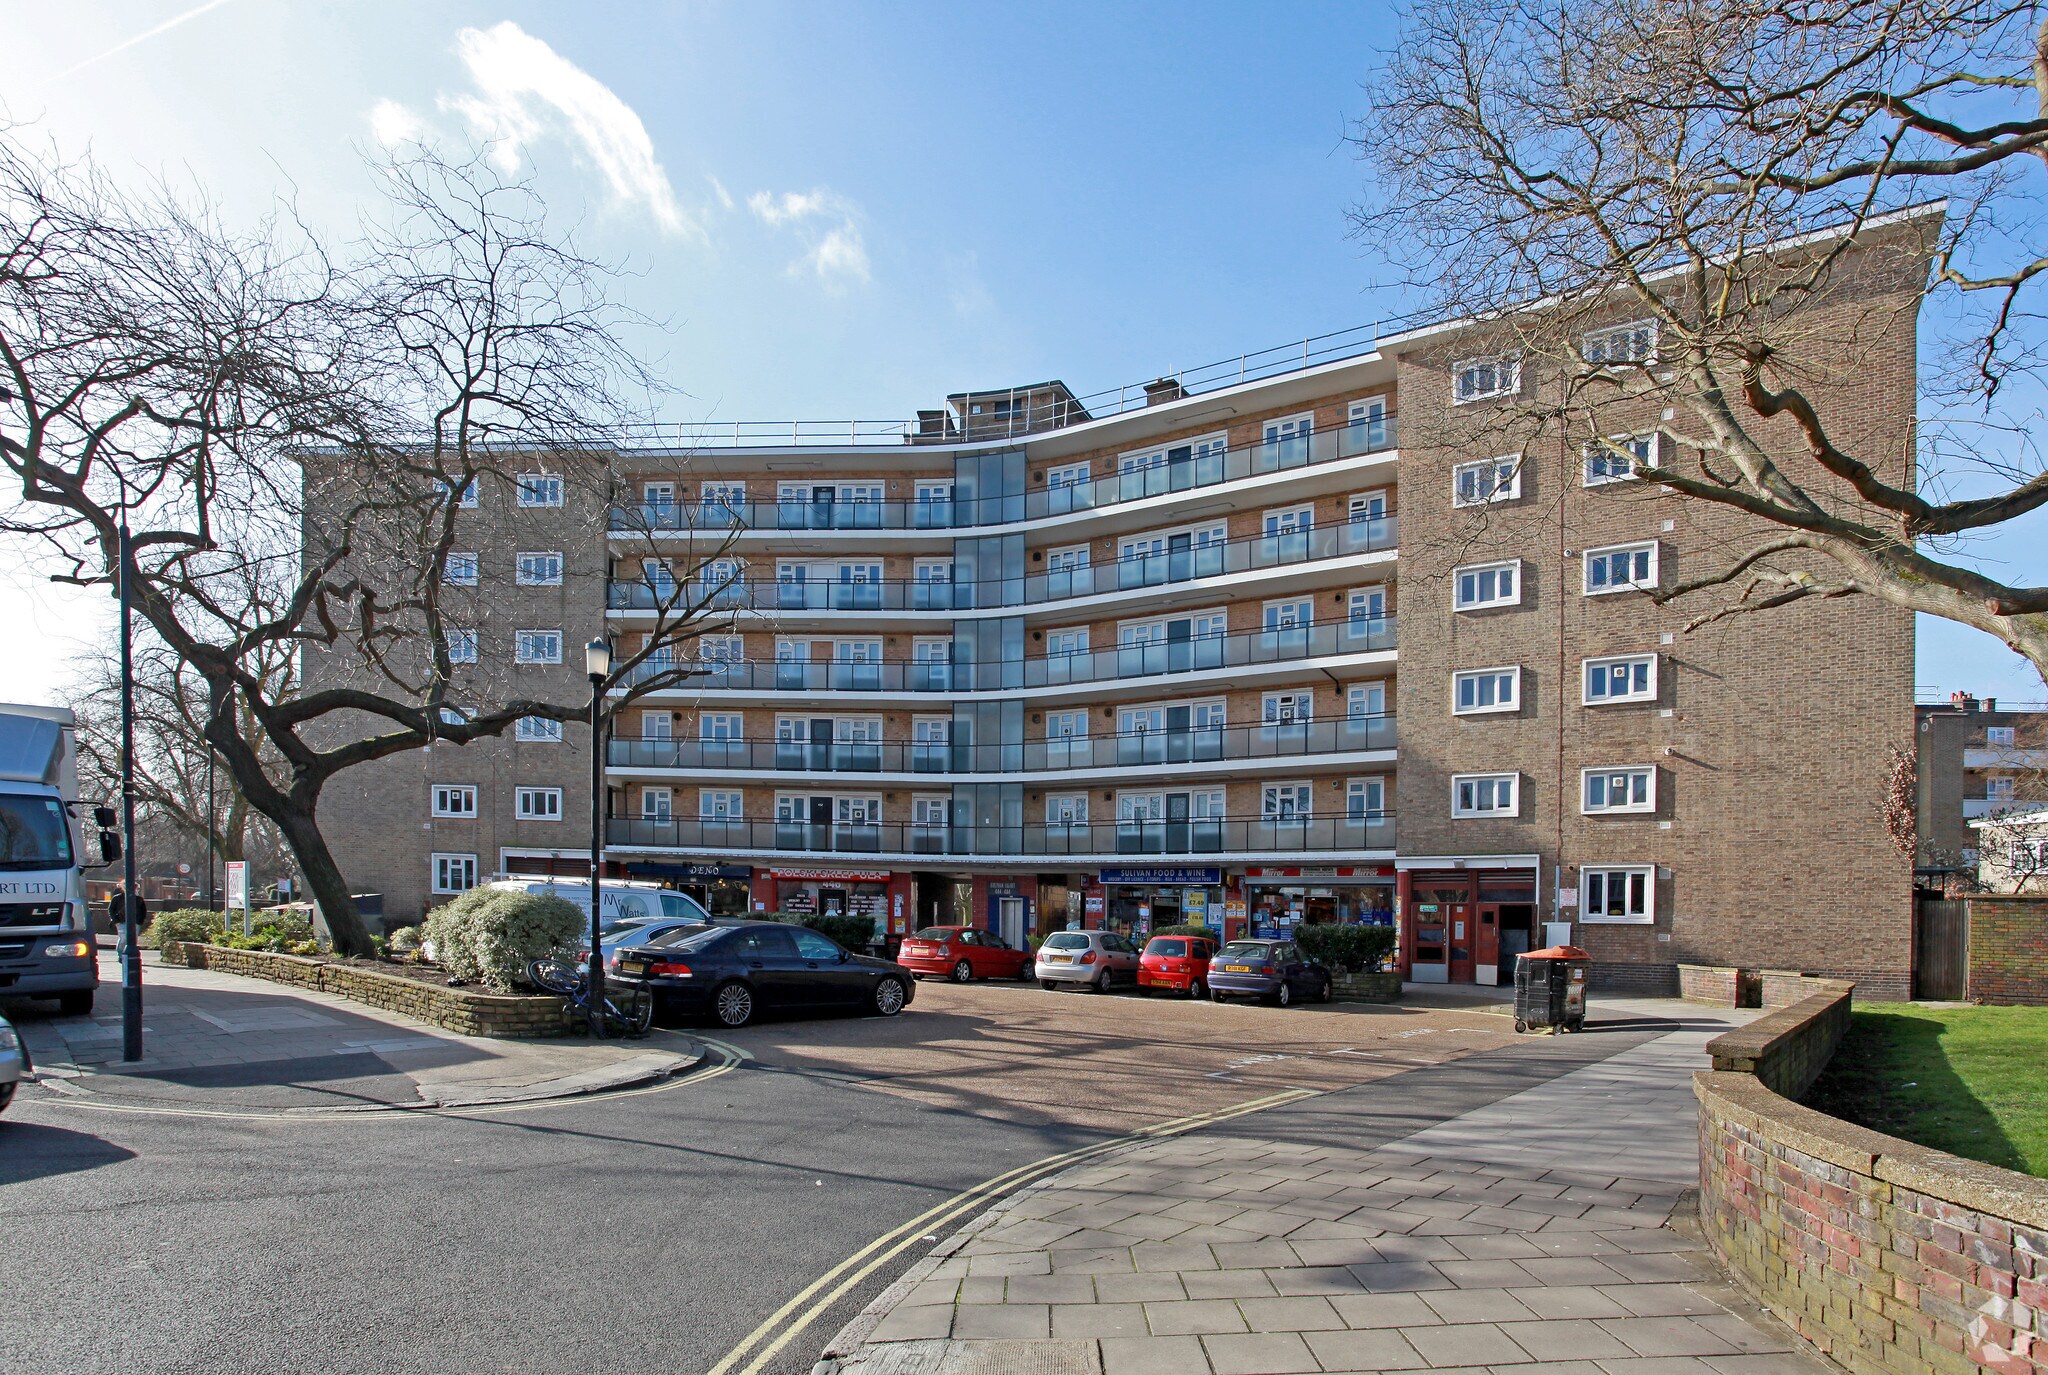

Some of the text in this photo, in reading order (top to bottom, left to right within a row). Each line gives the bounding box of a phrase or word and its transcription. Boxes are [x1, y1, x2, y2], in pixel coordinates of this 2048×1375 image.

[689, 866, 719, 875] DENO
[778, 869, 882, 880] POLSKI SKLEP ULA
[1121, 869, 1206, 877] SULIVAN FOOD & WINE
[1261, 868, 1285, 877] Mirror
[1352, 867, 1379, 876] Mirror
[25, 883, 60, 894] LTD.
[32, 908, 60, 916] LF
[618, 904, 645, 918] Watts
